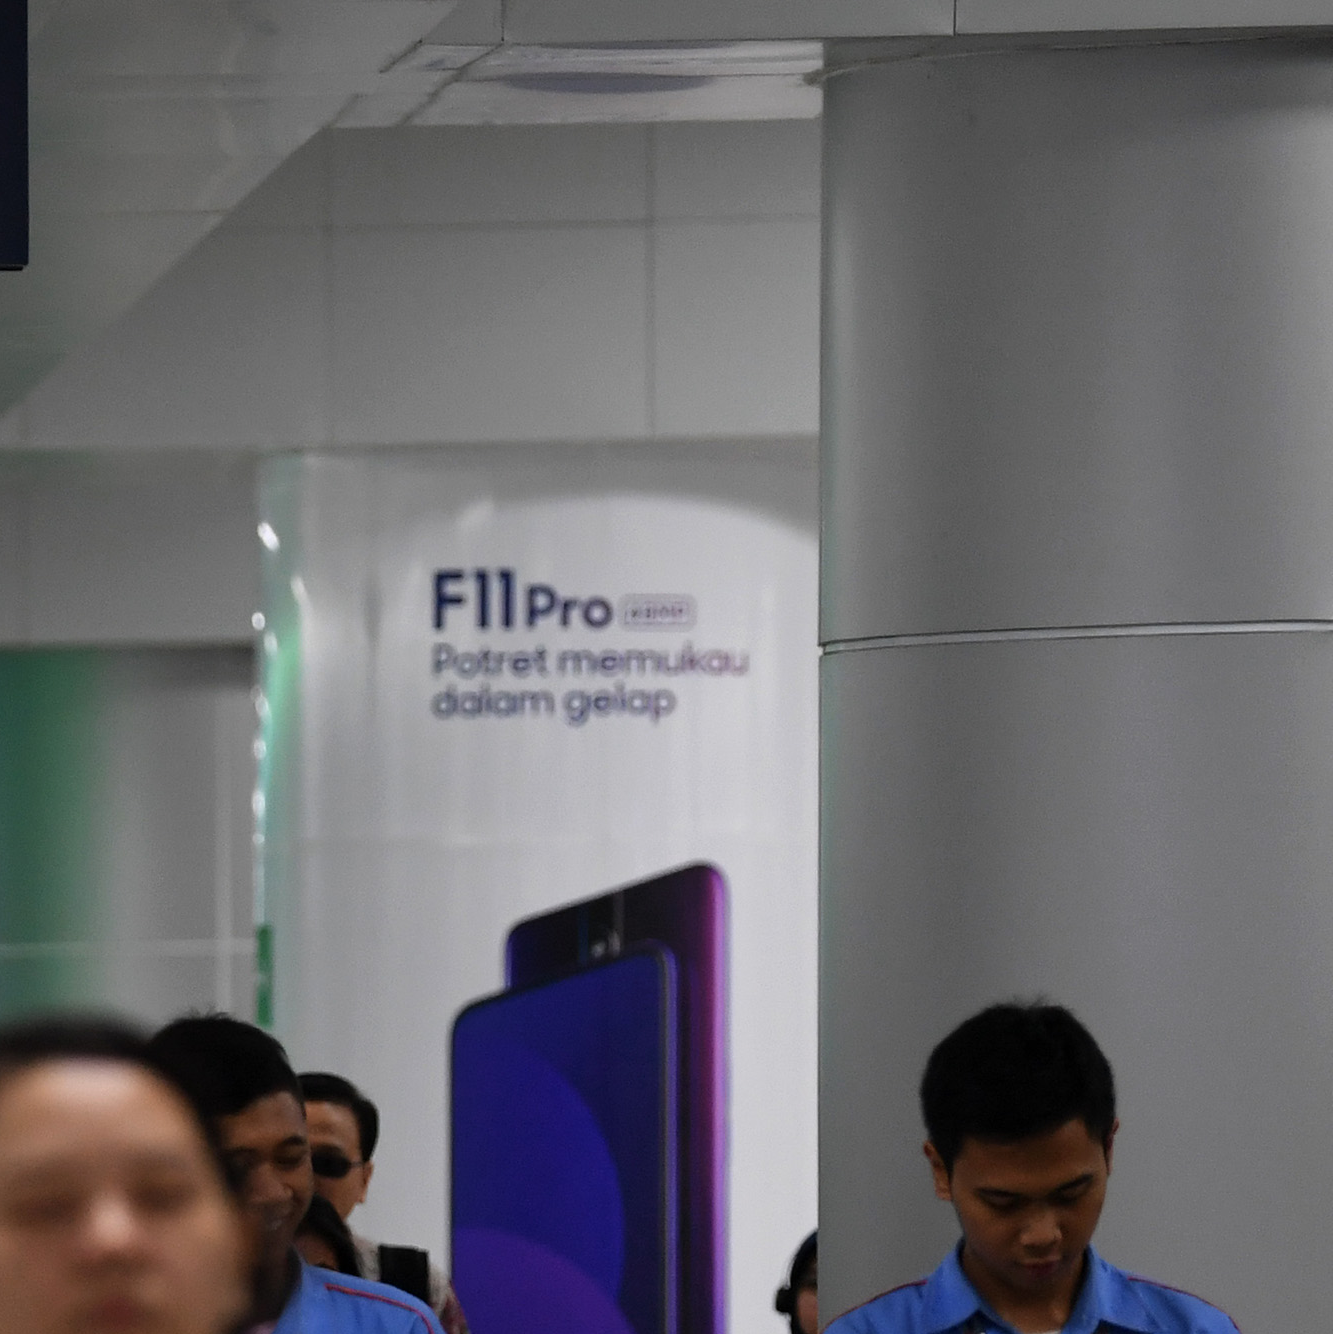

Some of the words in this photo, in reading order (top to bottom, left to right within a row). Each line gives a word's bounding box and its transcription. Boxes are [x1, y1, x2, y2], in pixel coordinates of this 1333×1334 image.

[433, 567, 516, 630] F11
[525, 584, 613, 630] Pro
[433, 642, 548, 678] Potret
[557, 641, 751, 677] memukau
[432, 681, 555, 720] dalam
[563, 681, 677, 728] gelap
